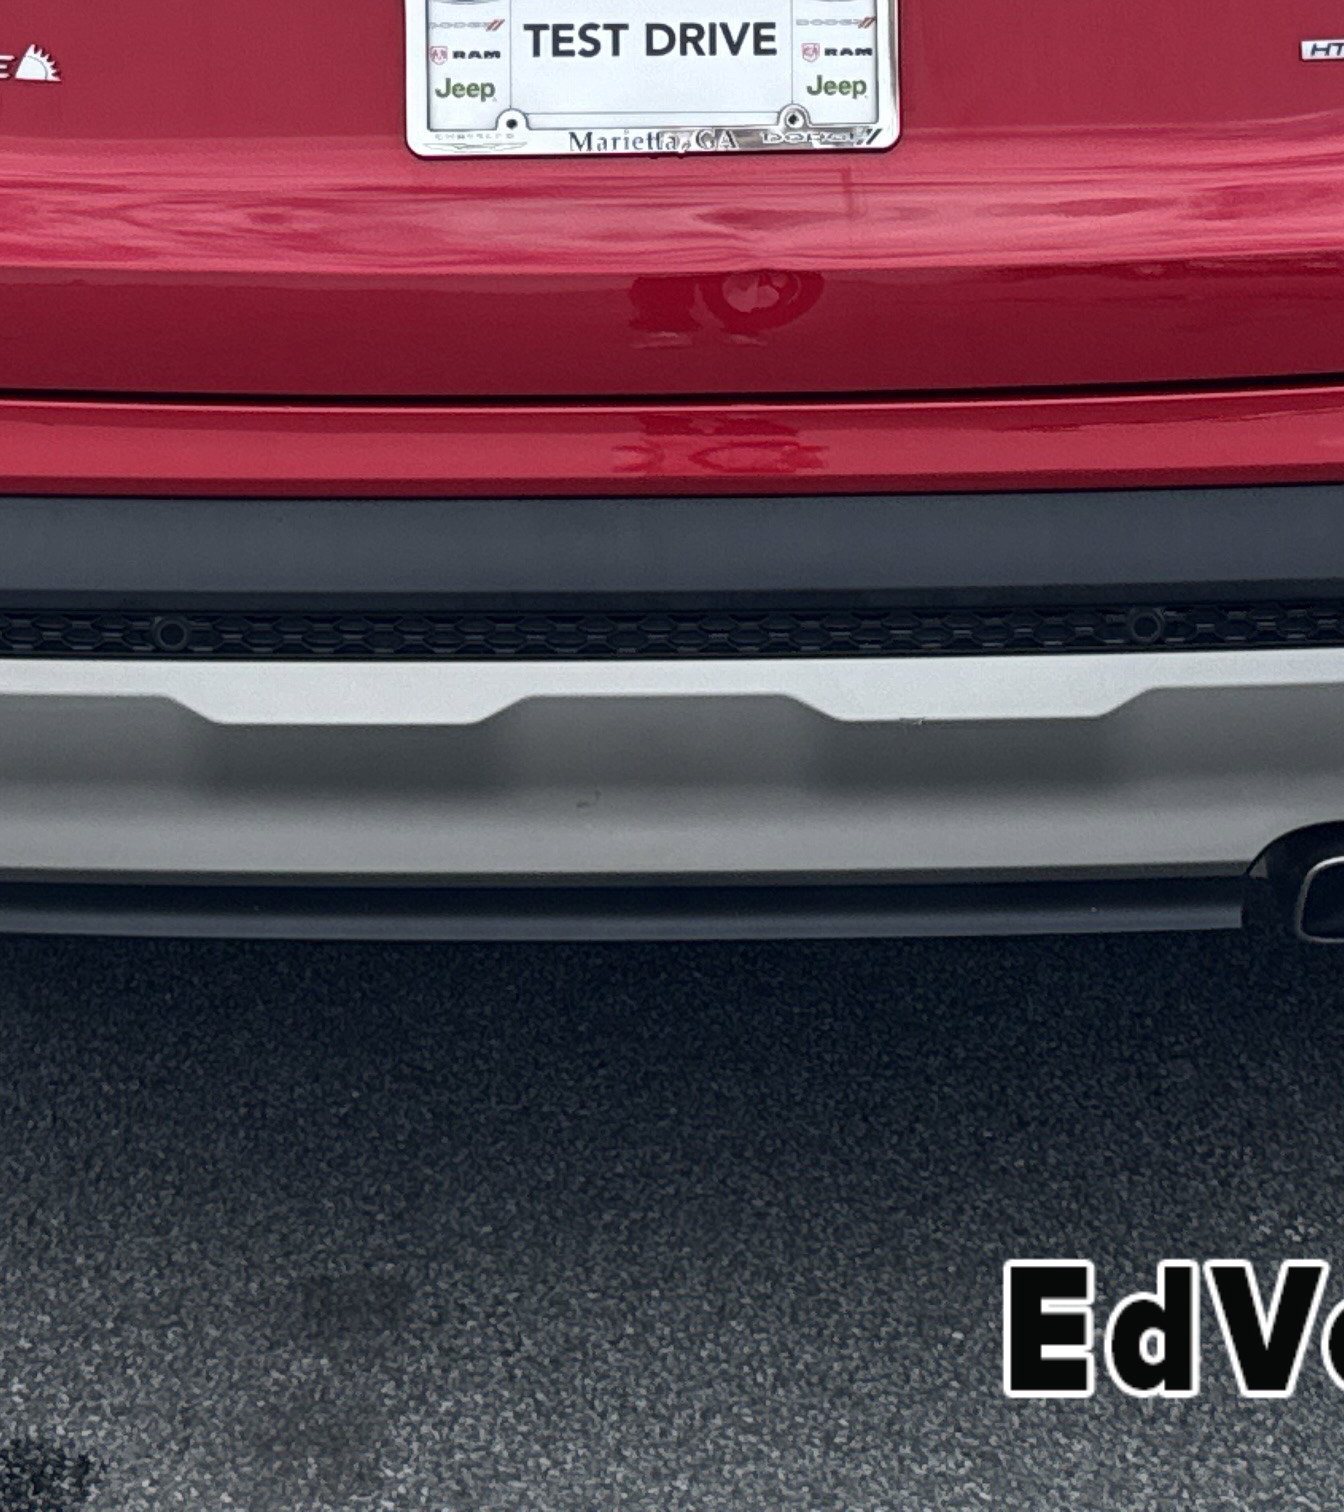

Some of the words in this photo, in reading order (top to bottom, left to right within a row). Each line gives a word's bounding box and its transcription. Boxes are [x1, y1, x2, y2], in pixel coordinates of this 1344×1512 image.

[523, 23, 629, 58] TEST
[645, 21, 777, 57] DRIVE
[452, 50, 501, 59] RAM
[824, 47, 873, 57] RAM
[435, 77, 495, 102] Jeep
[806, 74, 867, 99] Jeep
[694, 128, 740, 151] GA
